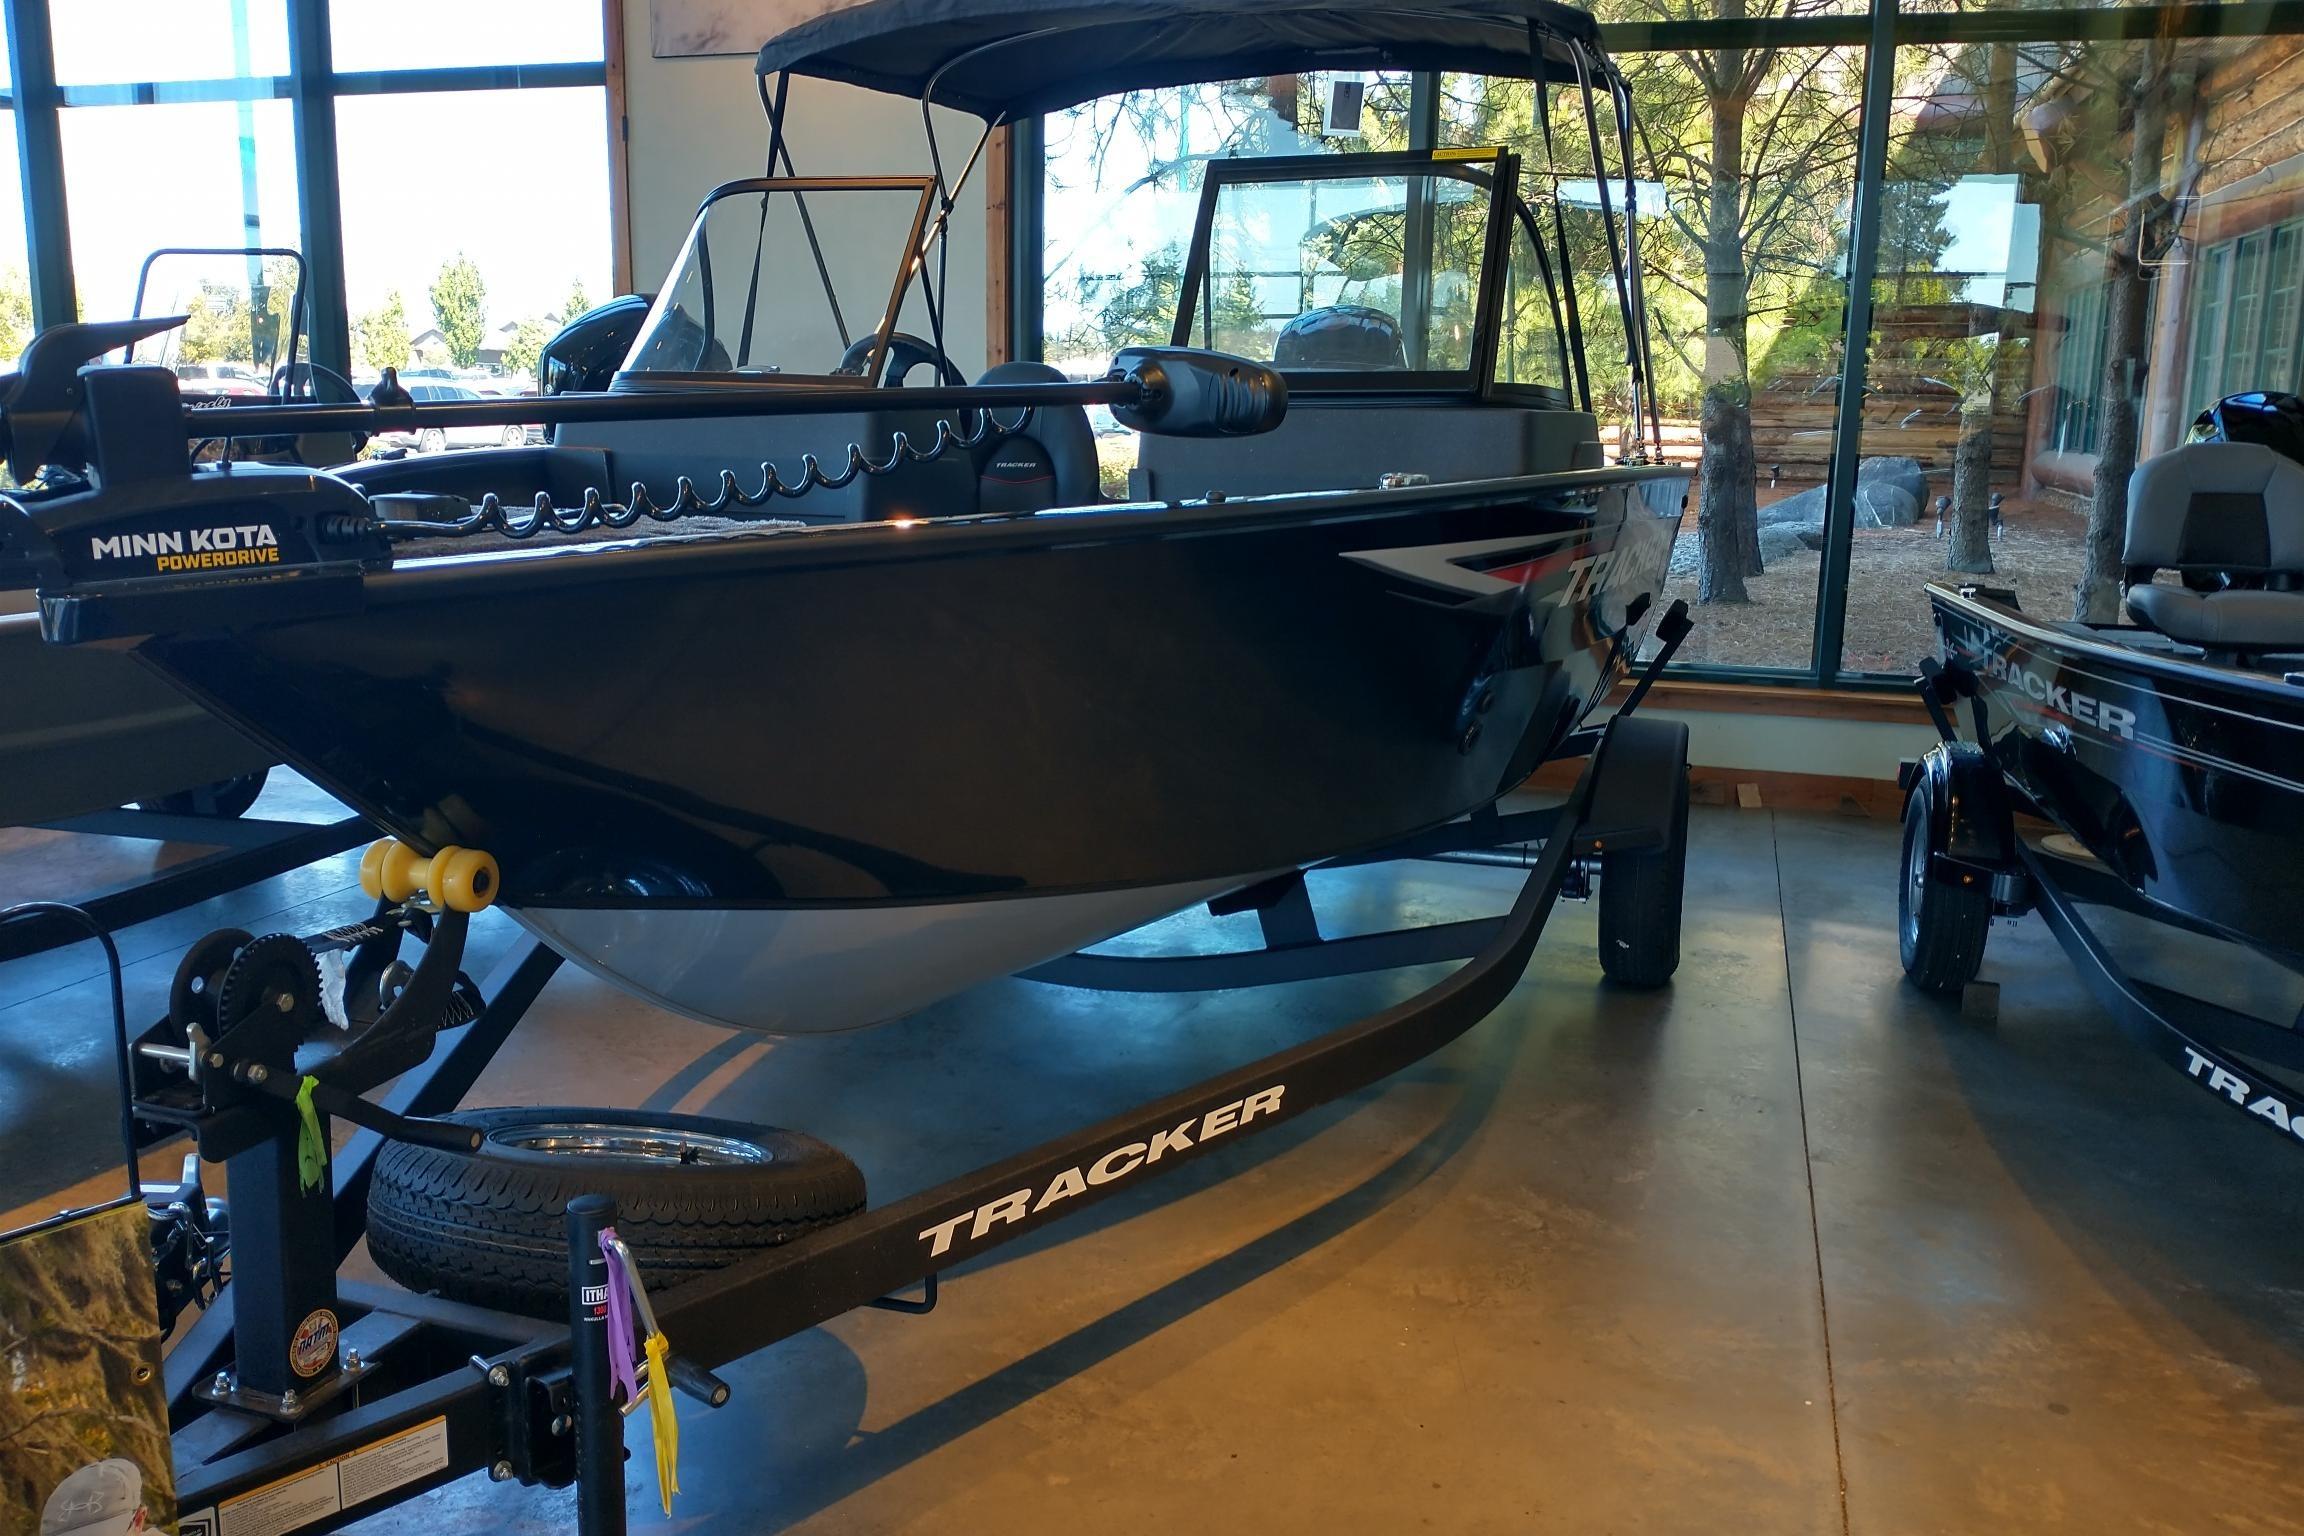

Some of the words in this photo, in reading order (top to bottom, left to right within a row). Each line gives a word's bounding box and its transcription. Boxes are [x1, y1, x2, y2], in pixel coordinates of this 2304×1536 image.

[91, 531, 183, 560] MINN
[190, 524, 277, 552] KOTA
[156, 547, 280, 572] POWERDRIVE
[1983, 648, 2136, 740] TRACKER
[918, 1084, 1286, 1258] TRACKER
